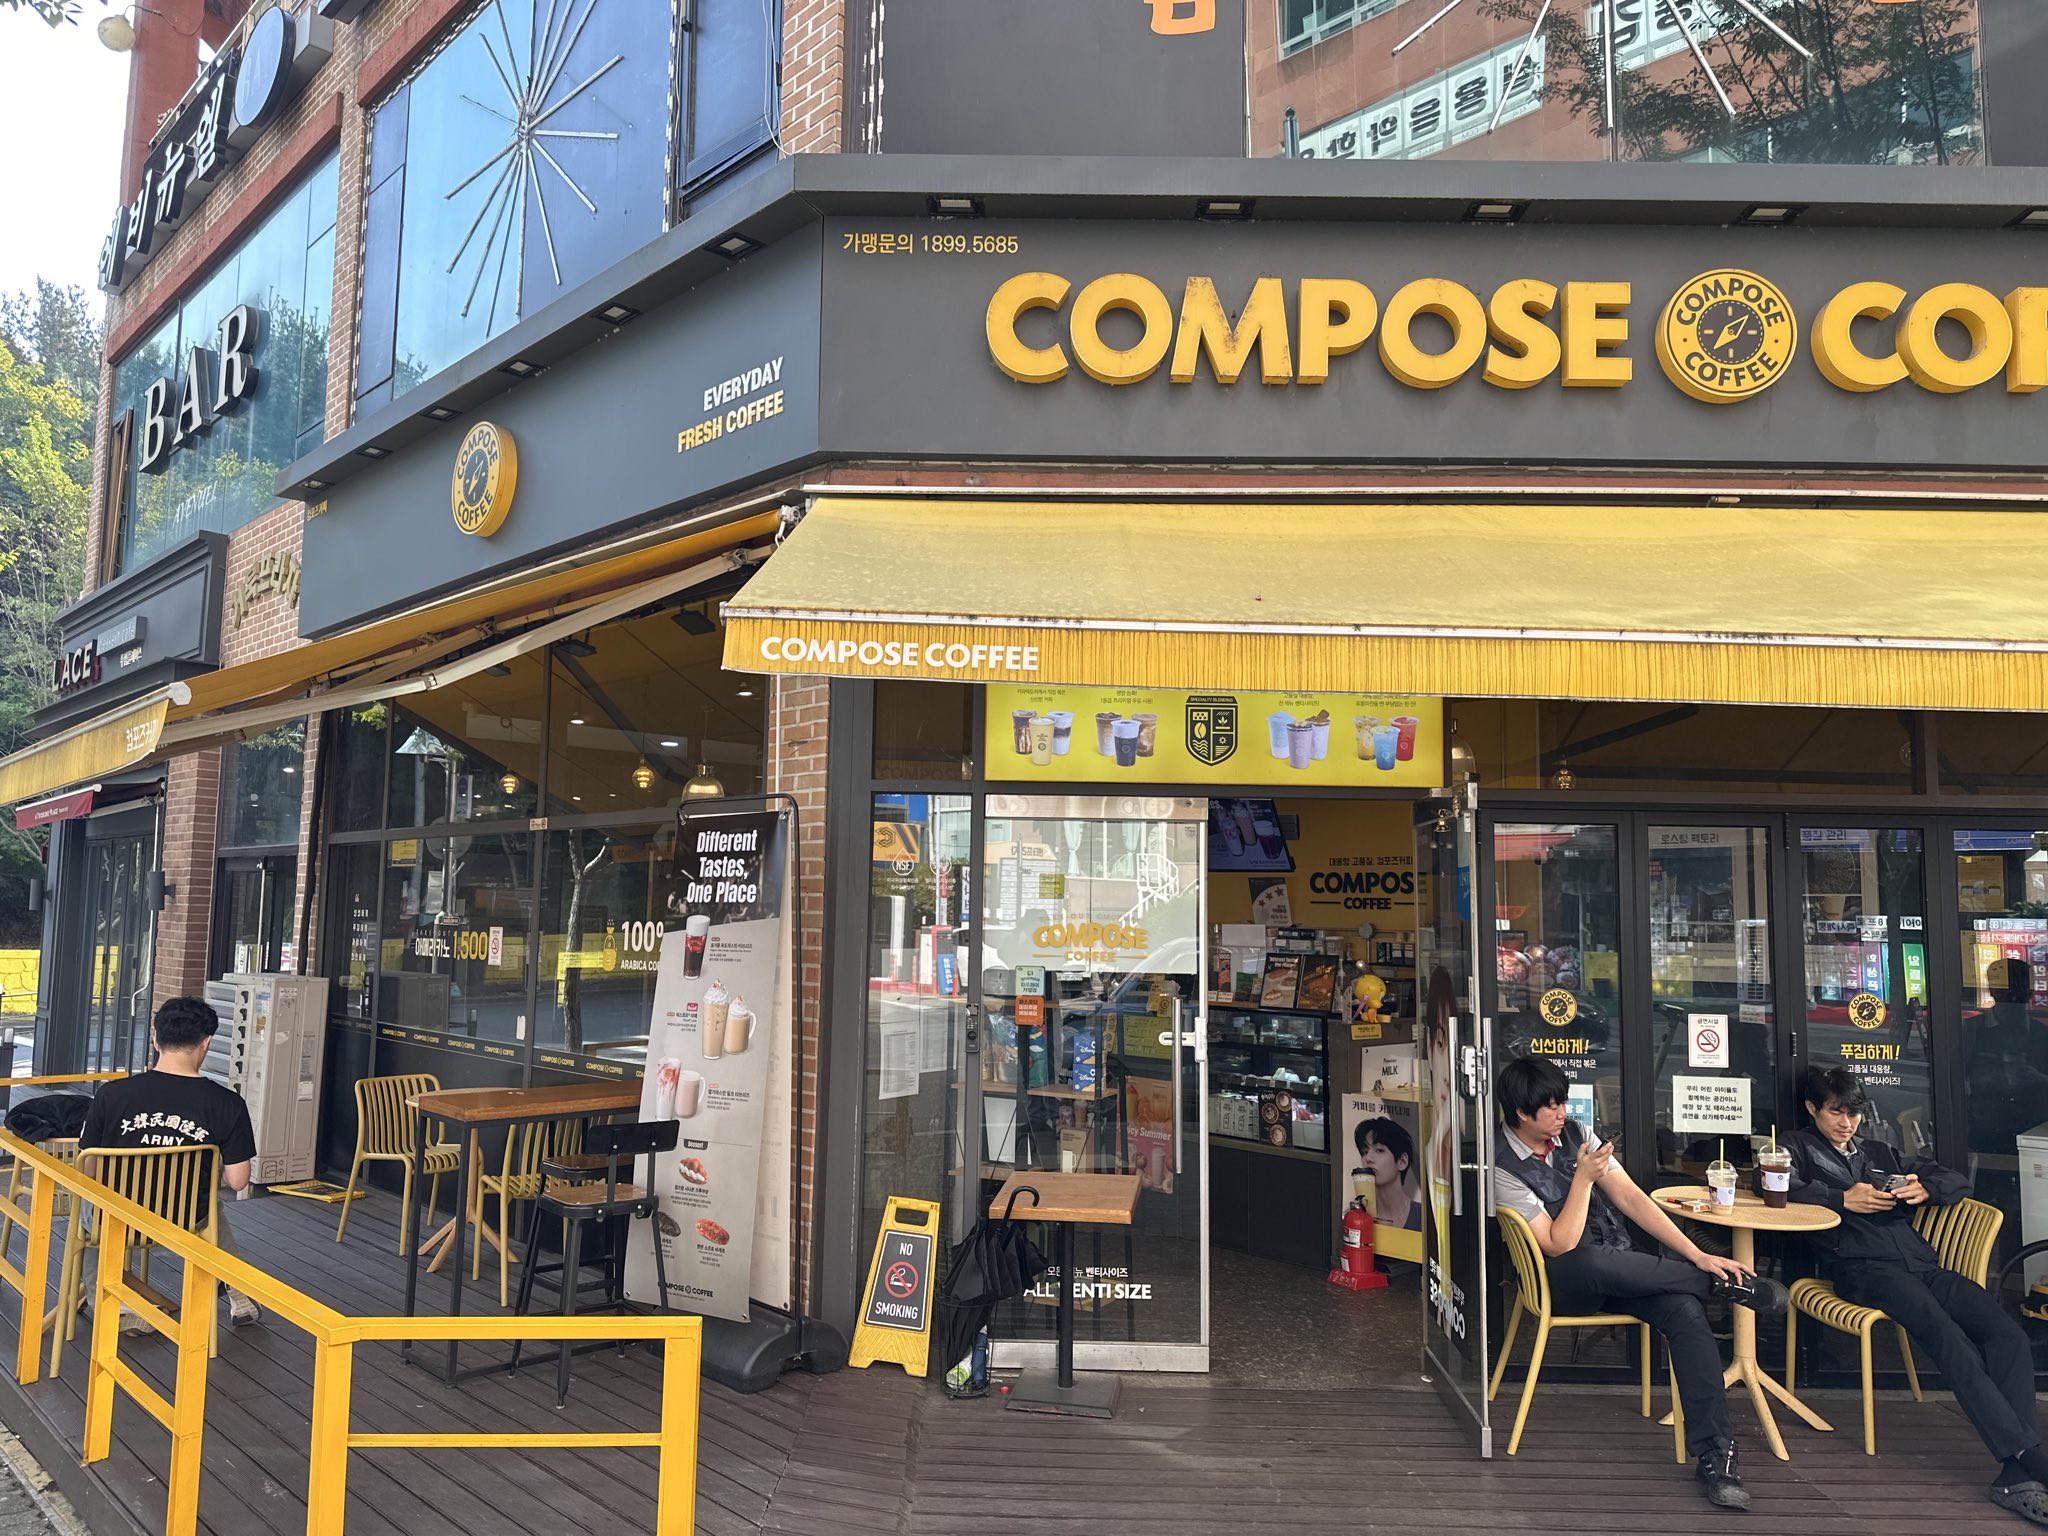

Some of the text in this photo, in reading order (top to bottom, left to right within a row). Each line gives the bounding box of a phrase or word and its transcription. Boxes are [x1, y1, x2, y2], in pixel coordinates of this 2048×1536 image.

[843, 233, 1019, 254] 가맹문의 1899.5685
[1676, 274, 1784, 330] COMPOSE
[986, 271, 1634, 390] COMPOSE
[1685, 351, 1779, 390] COFFEE
[139, 303, 259, 474] BAR
[704, 356, 784, 412] EVERYDAY
[677, 390, 784, 454] FRESH COFFEE
[457, 429, 498, 480] COMPOSE
[457, 488, 493, 527] COFFEE
[760, 636, 1039, 671] COMPOSE COFFEE
[697, 830, 757, 853] Different
[699, 856, 748, 879] Tastes,
[687, 882, 757, 903] One Place
[1343, 897, 1391, 910] COFFEE
[1033, 922, 1149, 949] COMPOSE
[415, 931, 488, 961] 아메리카노 1,500
[620, 959, 647, 970] ARABICA
[1064, 951, 1116, 962] COFFEE
[1541, 990, 1574, 1006] COMPOSE
[1850, 993, 1883, 1010] COMPOSE
[1544, 1012, 1572, 1024] COFFEE
[1853, 1016, 1881, 1028] COFFEE
[1530, 1038, 1590, 1055] 신선하게!
[1840, 1043, 1901, 1060] 푸짐하게!
[540, 1054, 575, 1067] COMPOSE COFFEE
[585, 1062, 604, 1072] COMPOSE
[608, 1065, 623, 1075] COFFEE
[1569, 1058, 1582, 1068] 직접
[1847, 1064, 1868, 1073] 고품질
[1381, 1065, 1399, 1077] MILK
[1564, 1070, 1578, 1079] 커피
[1700, 1085, 1712, 1093] 어린
[1352, 1100, 1376, 1113] 커피를
[1713, 1095, 1737, 1103] 공간이니
[1682, 1103, 1694, 1111] 매장
[1713, 1104, 1743, 1112] 테라스에서
[121, 1112, 209, 1142] 大韓民國陸軍
[1139, 1127, 1172, 1142] Summer
[141, 1133, 185, 1146] ARMY
[899, 1242, 913, 1256] NO
[1086, 1266, 1128, 1277] 벤티사이즈
[692, 1287, 714, 1298] COFFEE
[1056, 1282, 1111, 1299] ENTI
[1114, 1283, 1152, 1300] SIZE
[875, 1302, 918, 1320] SMOKING
